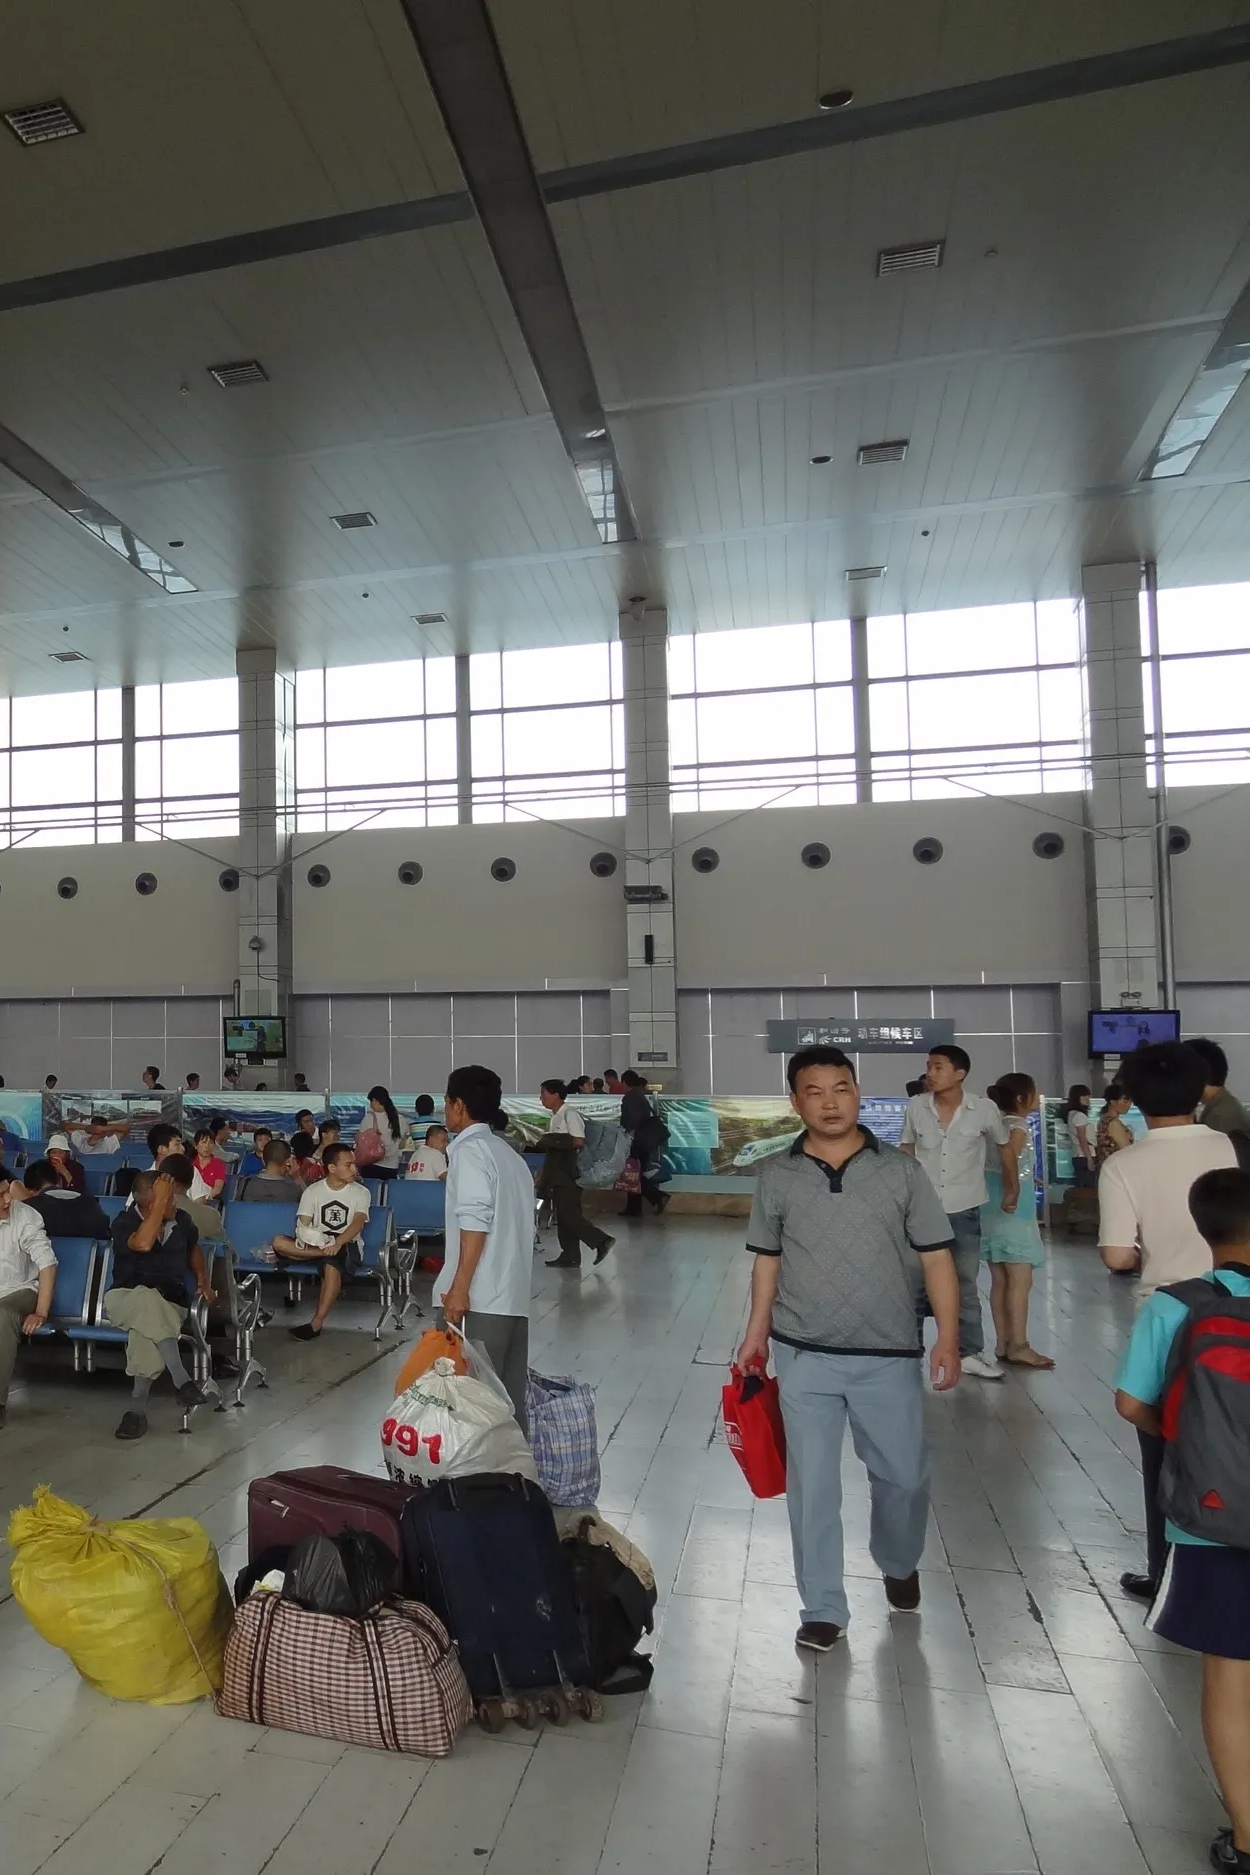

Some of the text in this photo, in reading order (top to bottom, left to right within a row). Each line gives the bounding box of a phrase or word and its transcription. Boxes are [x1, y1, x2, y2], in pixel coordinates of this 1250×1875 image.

[857, 1026, 924, 1040] 动车组候车区
